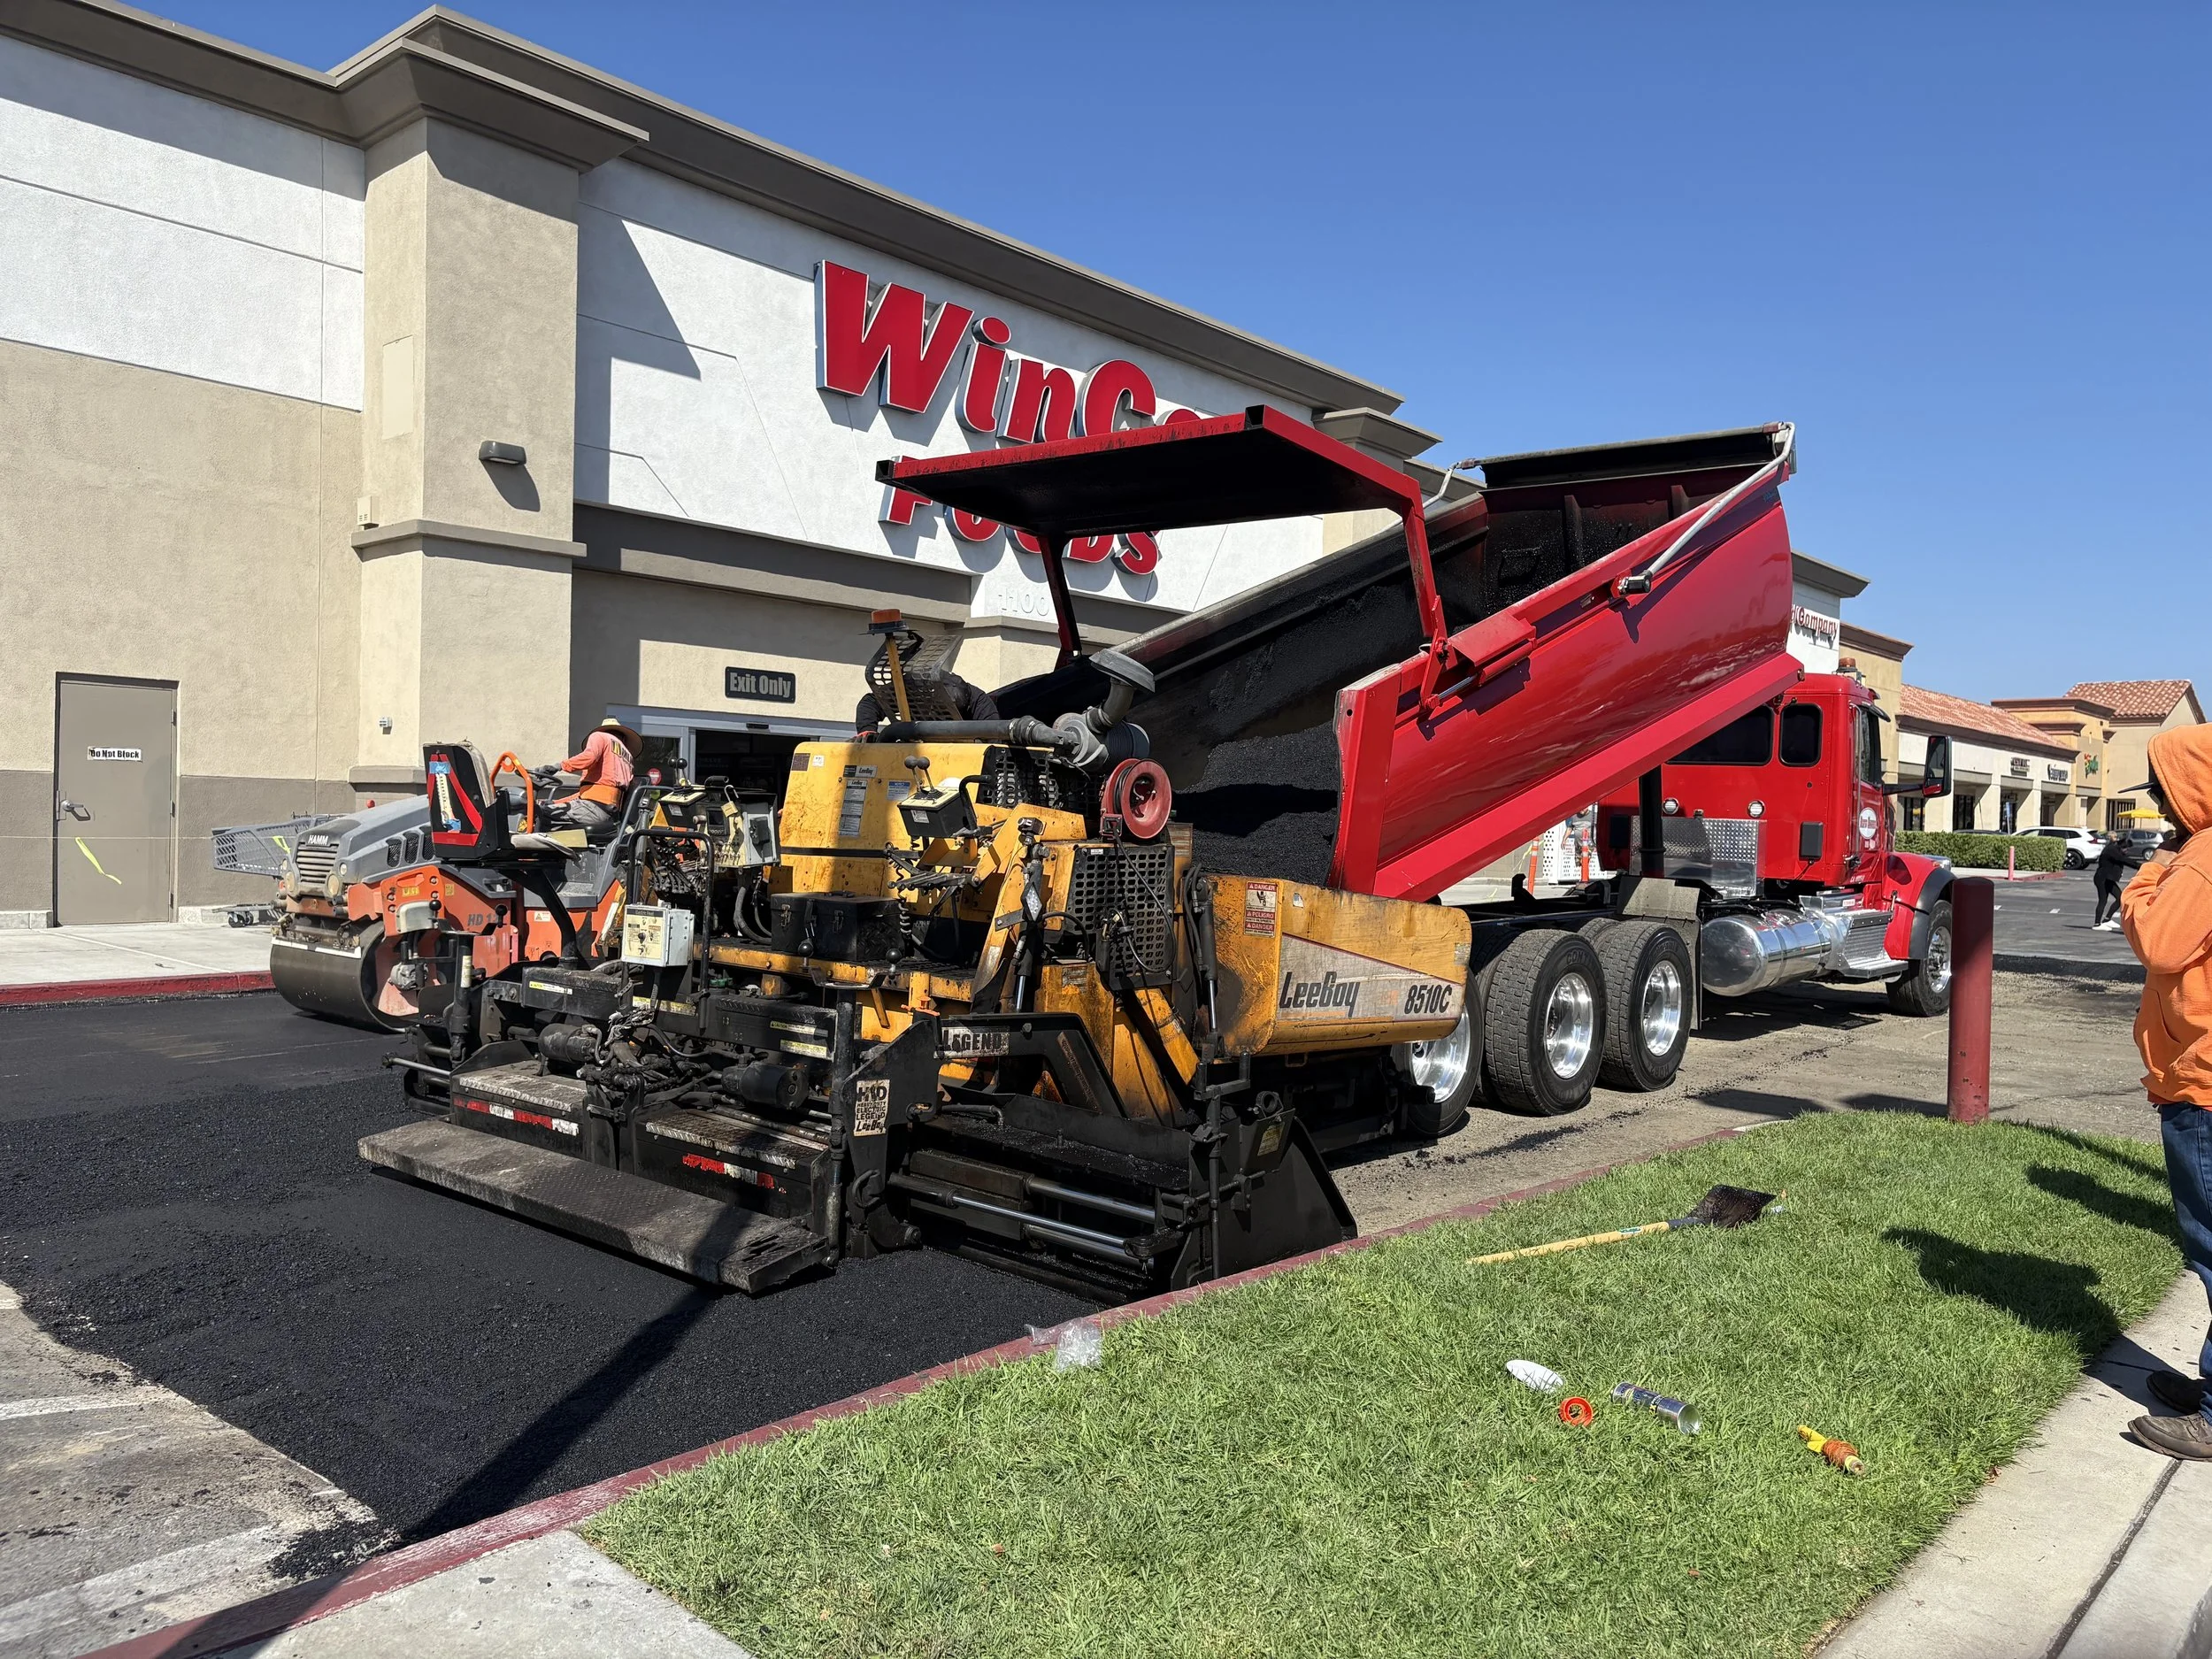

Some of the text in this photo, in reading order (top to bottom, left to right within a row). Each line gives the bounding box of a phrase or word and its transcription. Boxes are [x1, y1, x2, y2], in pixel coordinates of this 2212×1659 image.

[815, 259, 1203, 442] WinC
[1796, 606, 1839, 641] Company
[730, 672, 792, 698] Exit Only
[102, 749, 116, 758] Not
[117, 749, 140, 758] Block
[308, 834, 329, 846] HAMM
[467, 913, 484, 926] HD
[1279, 971, 1361, 1018] LeeBoy
[1404, 984, 1452, 1014] 8510C
